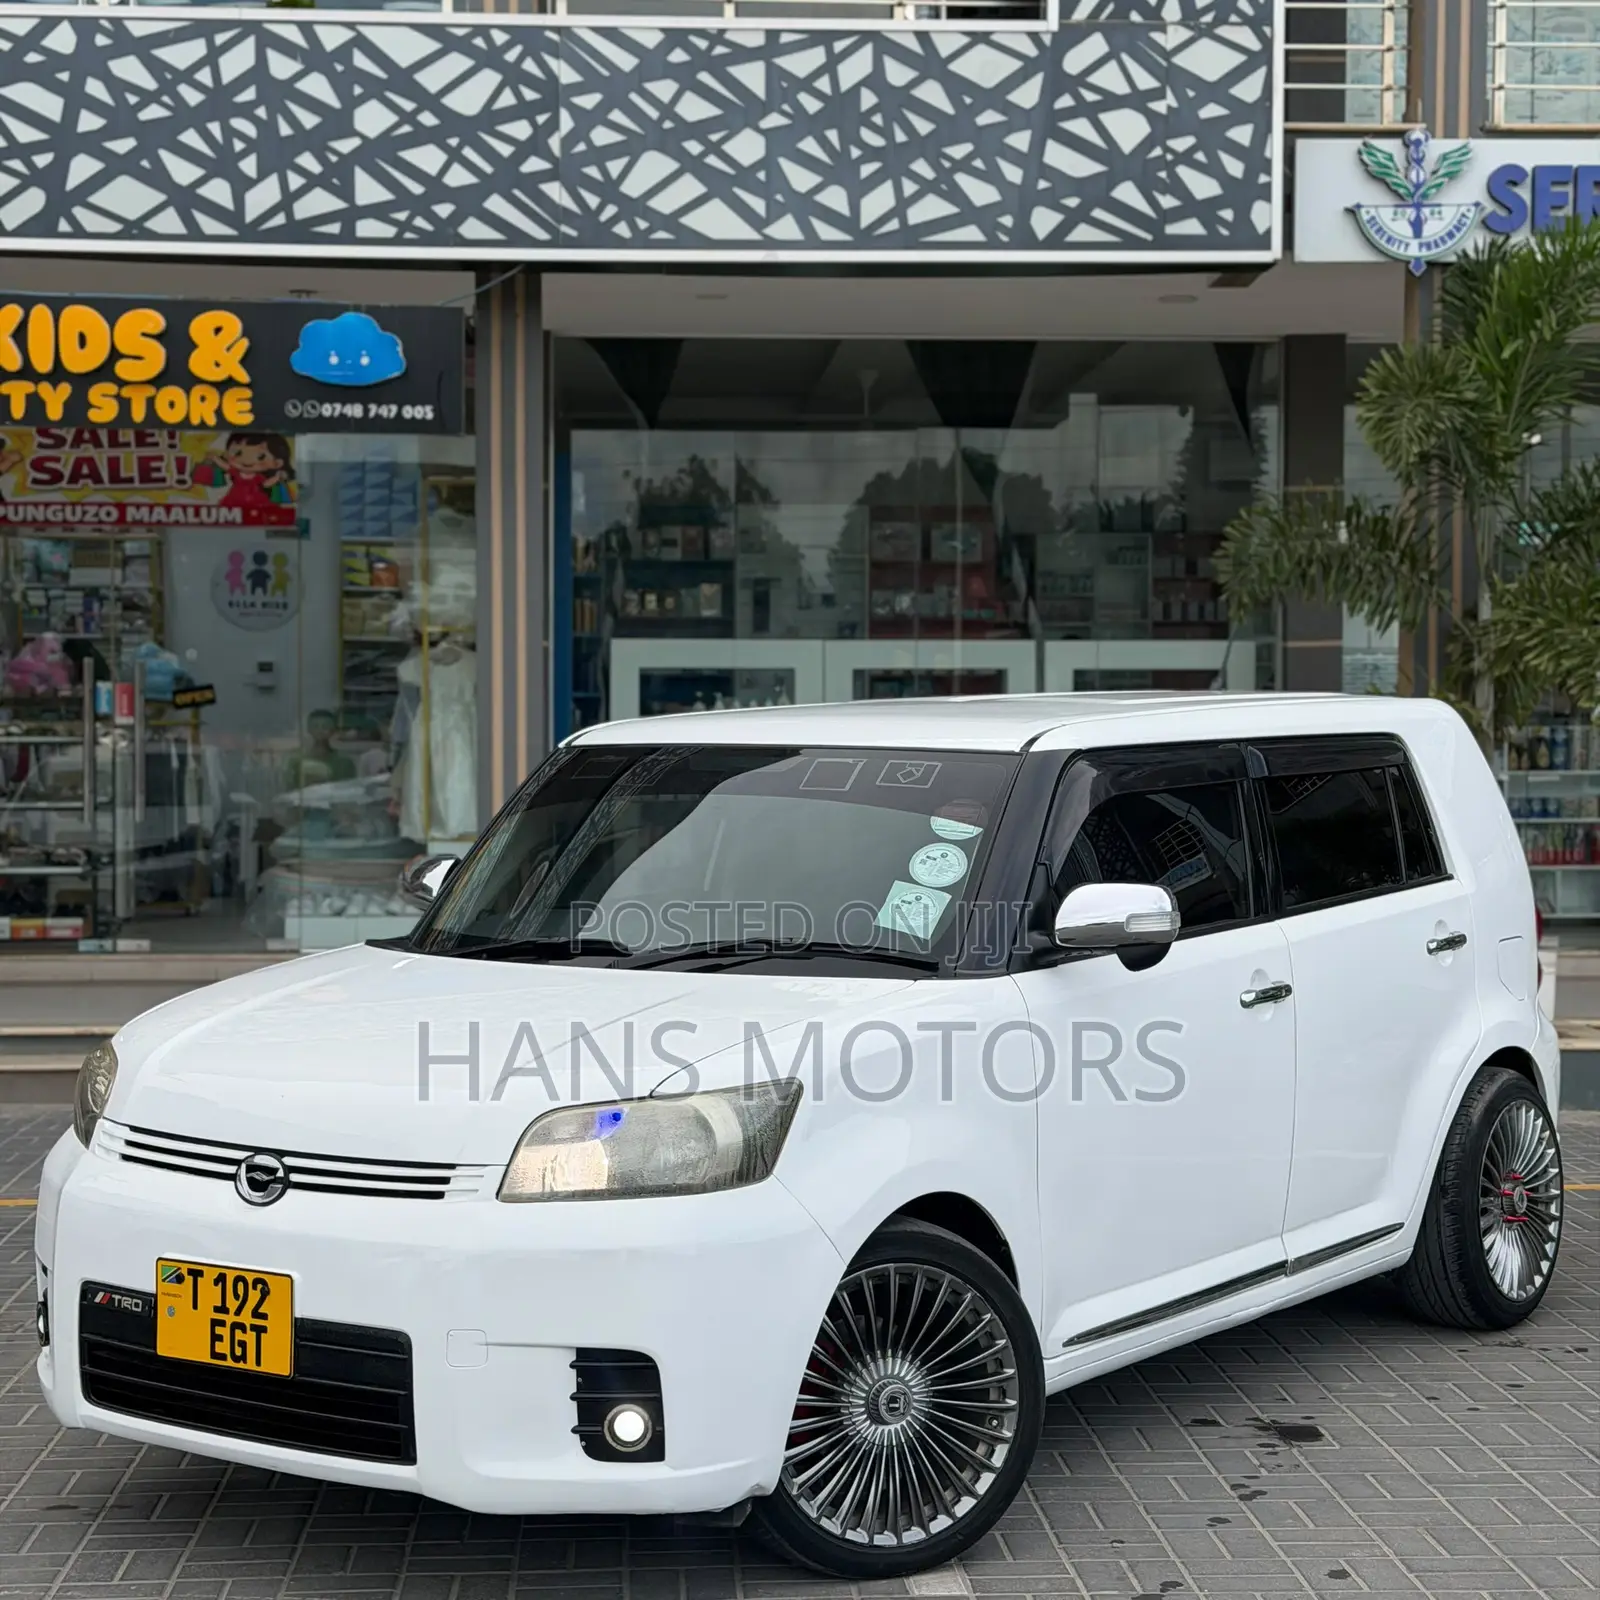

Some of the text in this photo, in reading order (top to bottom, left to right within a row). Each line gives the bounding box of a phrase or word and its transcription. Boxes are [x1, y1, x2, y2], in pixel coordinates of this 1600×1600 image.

[1366, 211, 1471, 254] SERENITY PHARMACY
[188, 309, 251, 385] &
[0, 380, 255, 427] TY STORE
[321, 402, 434, 420] 0748 747 005
[35, 428, 178, 449] SALE!
[29, 455, 188, 486] SALE!
[126, 505, 243, 523] MAALUM
[111, 1294, 143, 1313] TRD
[186, 1267, 271, 1321] T 192
[209, 1317, 268, 1367] EGT
